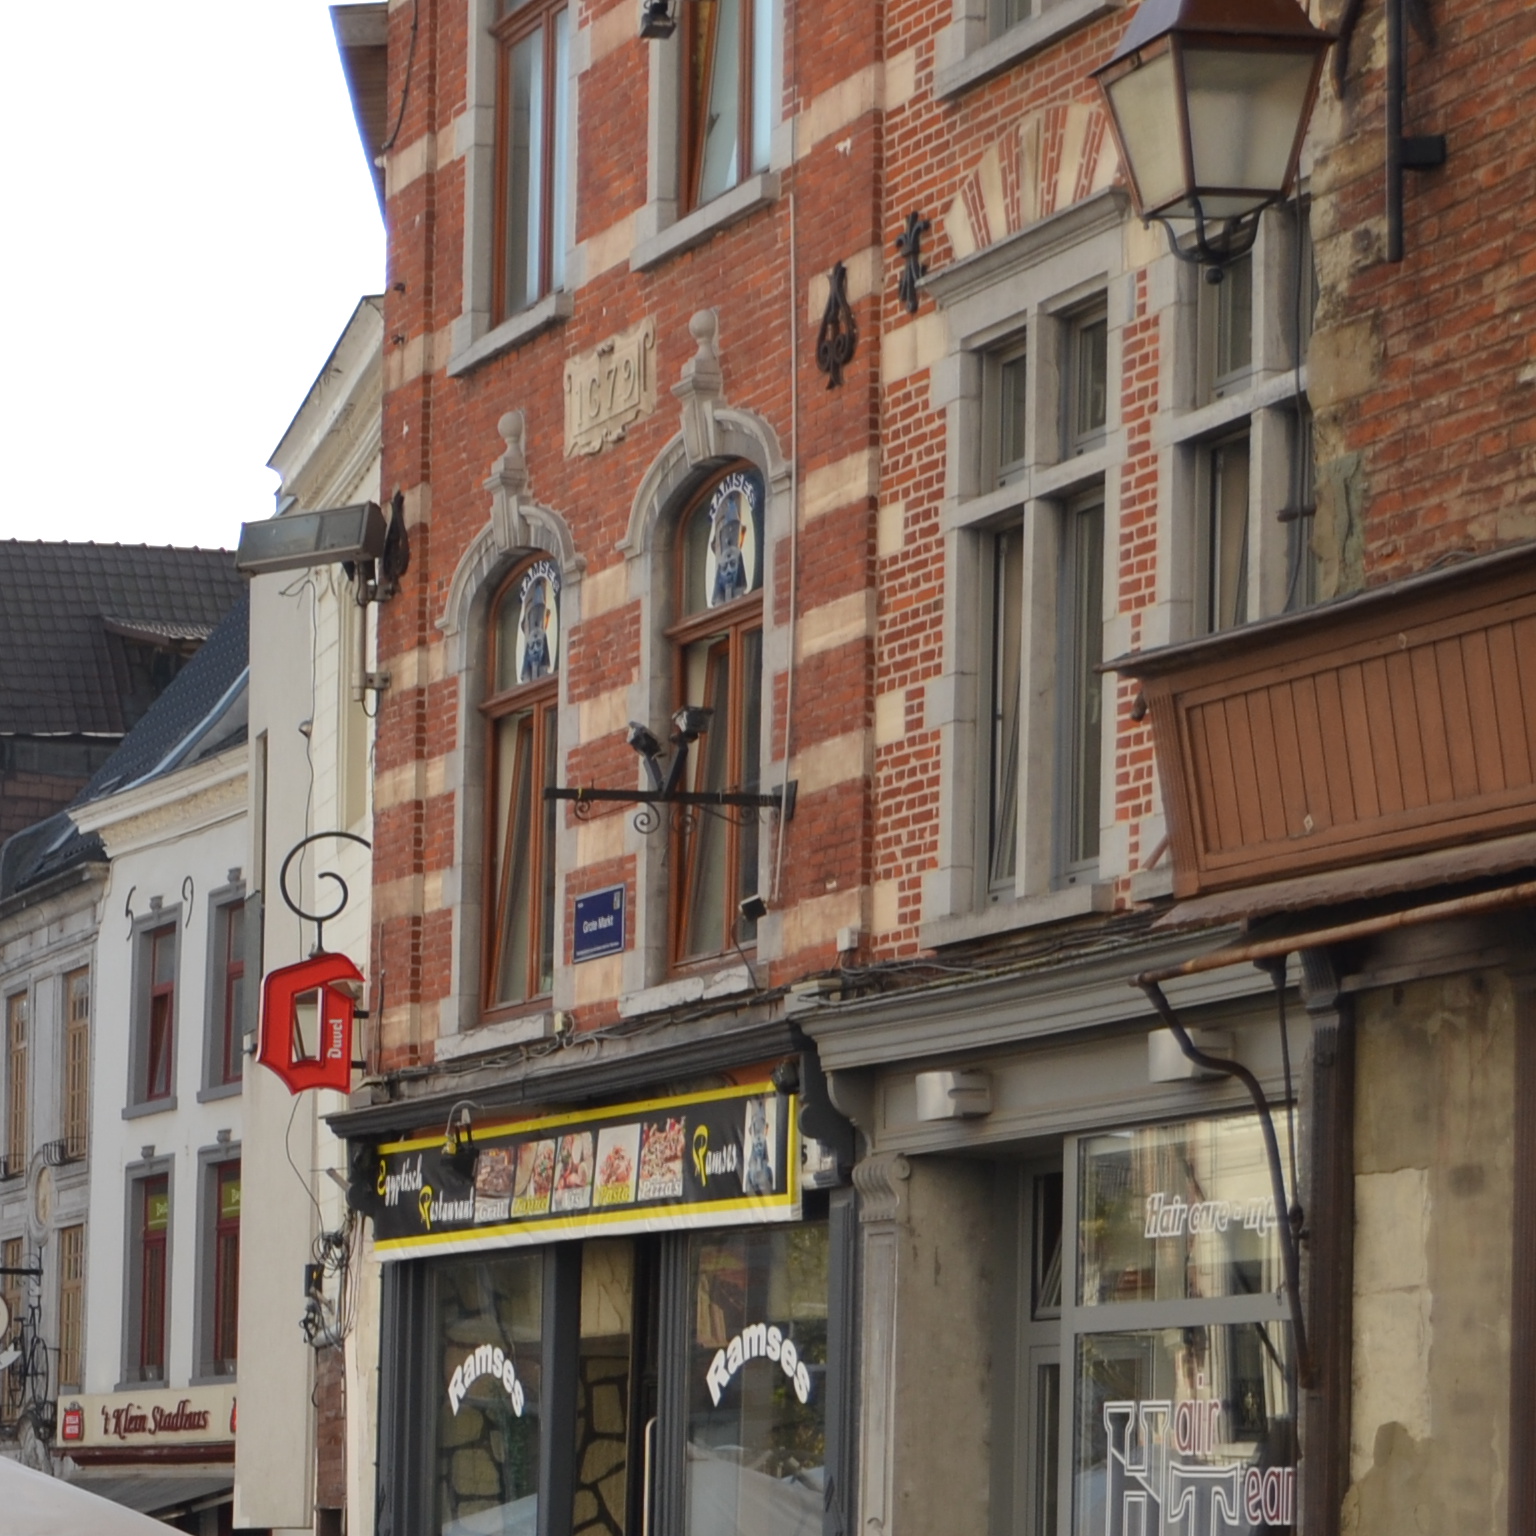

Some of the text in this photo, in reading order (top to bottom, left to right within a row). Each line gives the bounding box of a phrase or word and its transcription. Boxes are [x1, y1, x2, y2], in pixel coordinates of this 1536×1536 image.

[708, 472, 755, 521] RAMSES
[598, 914, 614, 930] Markt
[327, 1018, 343, 1059] Duvel
[693, 1124, 737, 1187] Ramses
[419, 1185, 475, 1230] Restaurant
[599, 1184, 630, 1202] Pasta
[641, 1177, 680, 1197] Pizza's
[479, 1201, 505, 1219] Grill
[1144, 1193, 1188, 1238] Hair
[1188, 1201, 1230, 1234] care
[447, 1343, 524, 1418] Ramses
[705, 1322, 811, 1407] Ramses
[112, 1403, 148, 1440] Klein
